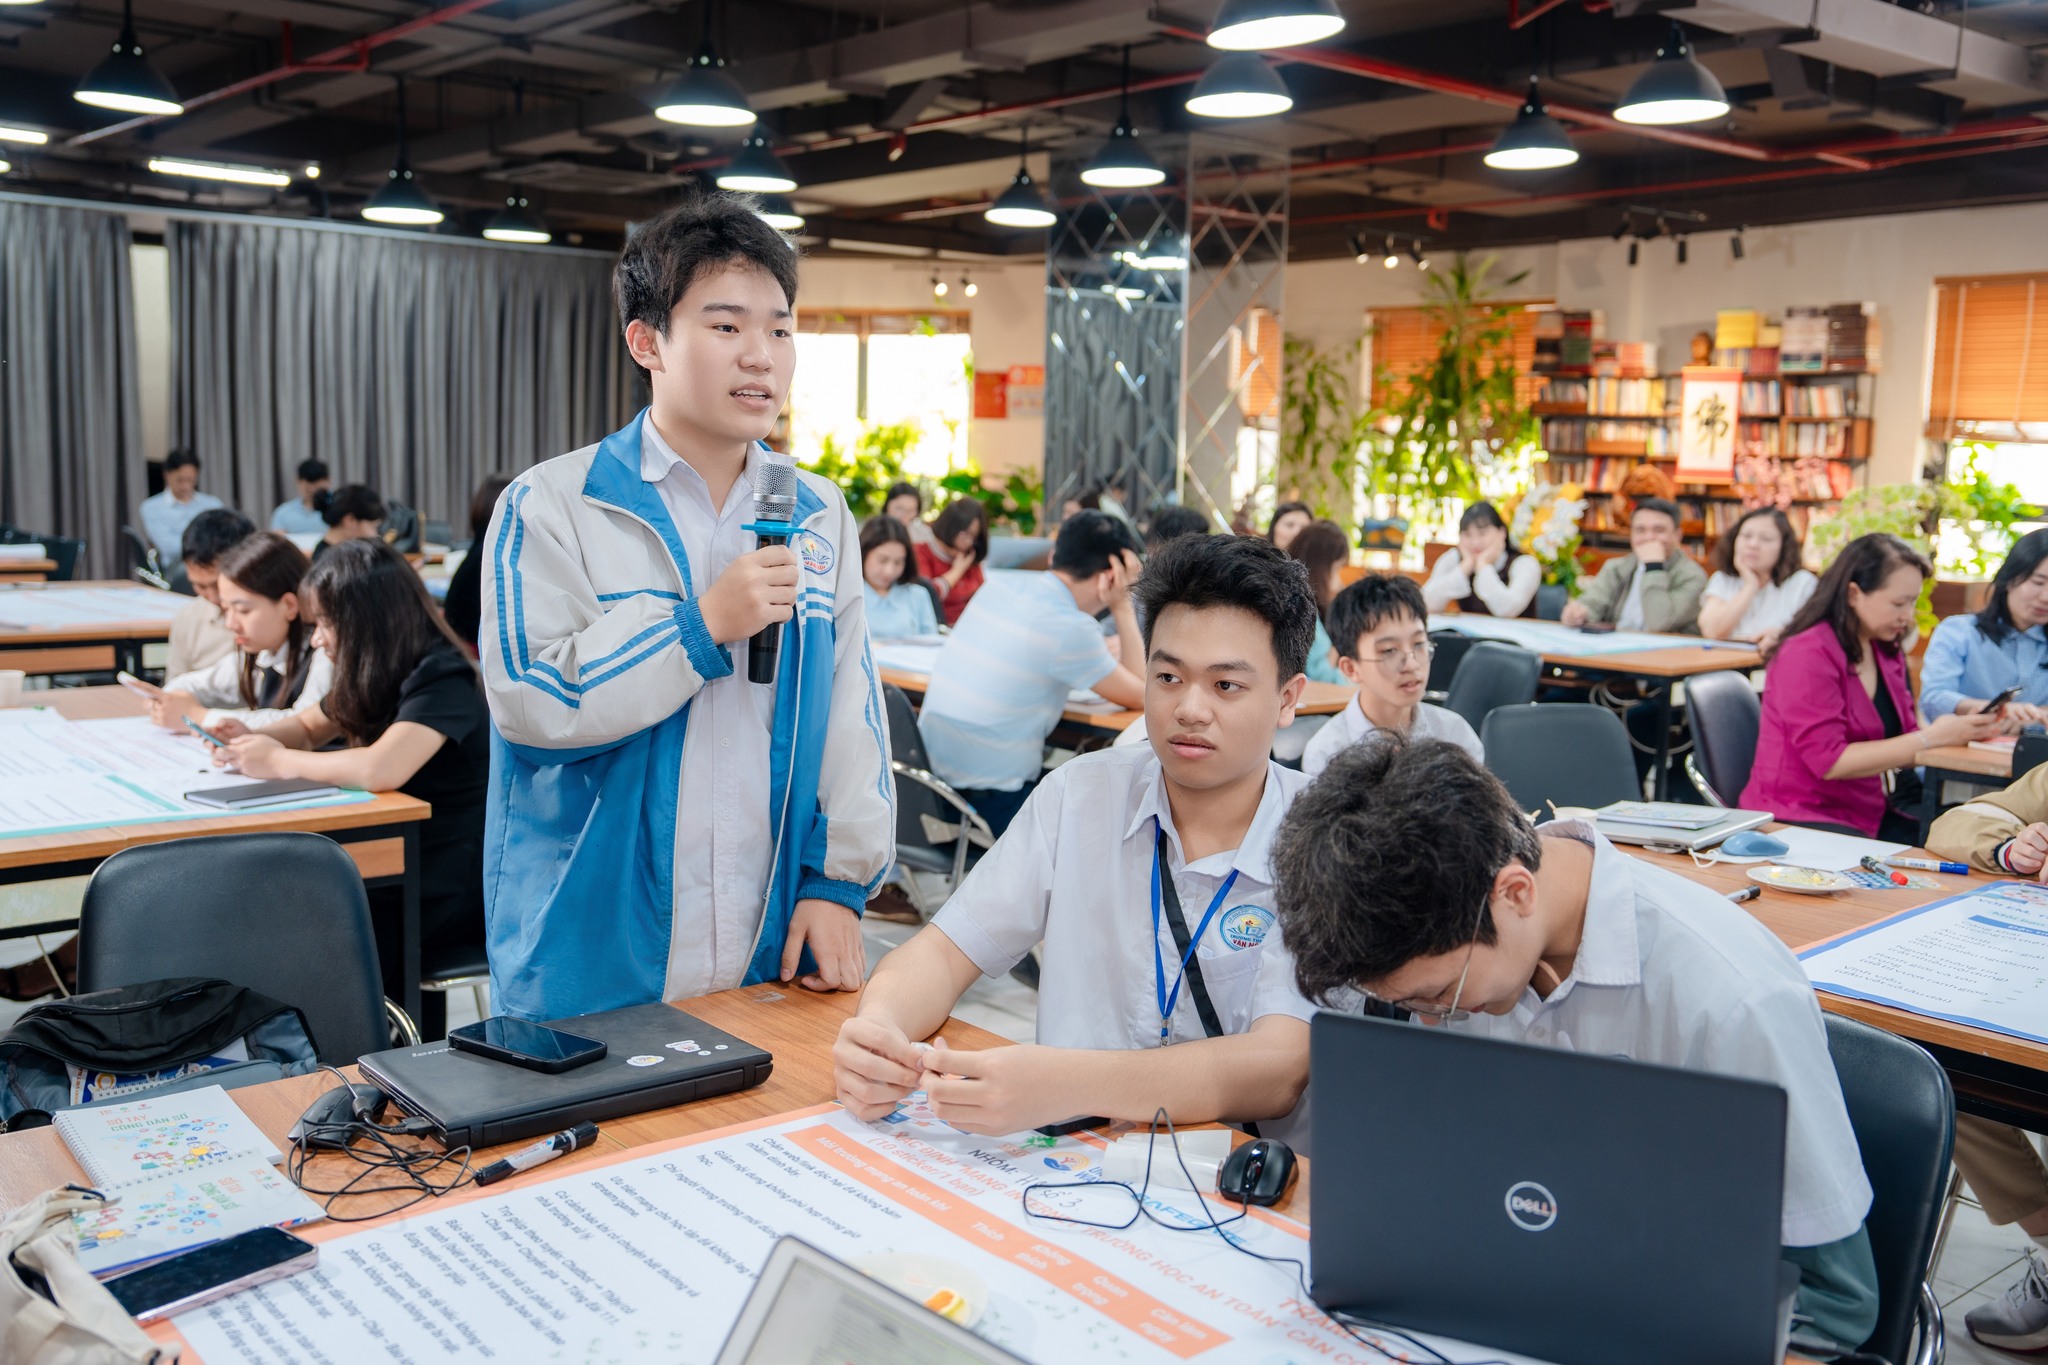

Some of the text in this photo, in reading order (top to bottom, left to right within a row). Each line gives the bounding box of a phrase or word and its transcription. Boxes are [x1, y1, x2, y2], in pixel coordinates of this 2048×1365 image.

[864, 1138, 903, 1151] (10
[947, 1179, 985, 1196] bạn)
[967, 1149, 1018, 1174] NHÓM:
[764, 1183, 791, 1199] không
[854, 1192, 882, 1209] không
[1512, 1196, 1551, 1217] DELL
[919, 1148, 967, 1167] ĐỊNH
[1080, 1225, 1154, 1261] TRƯỜNG
[1149, 1260, 1195, 1284] HỌC
[1190, 1284, 1225, 1300] AN
